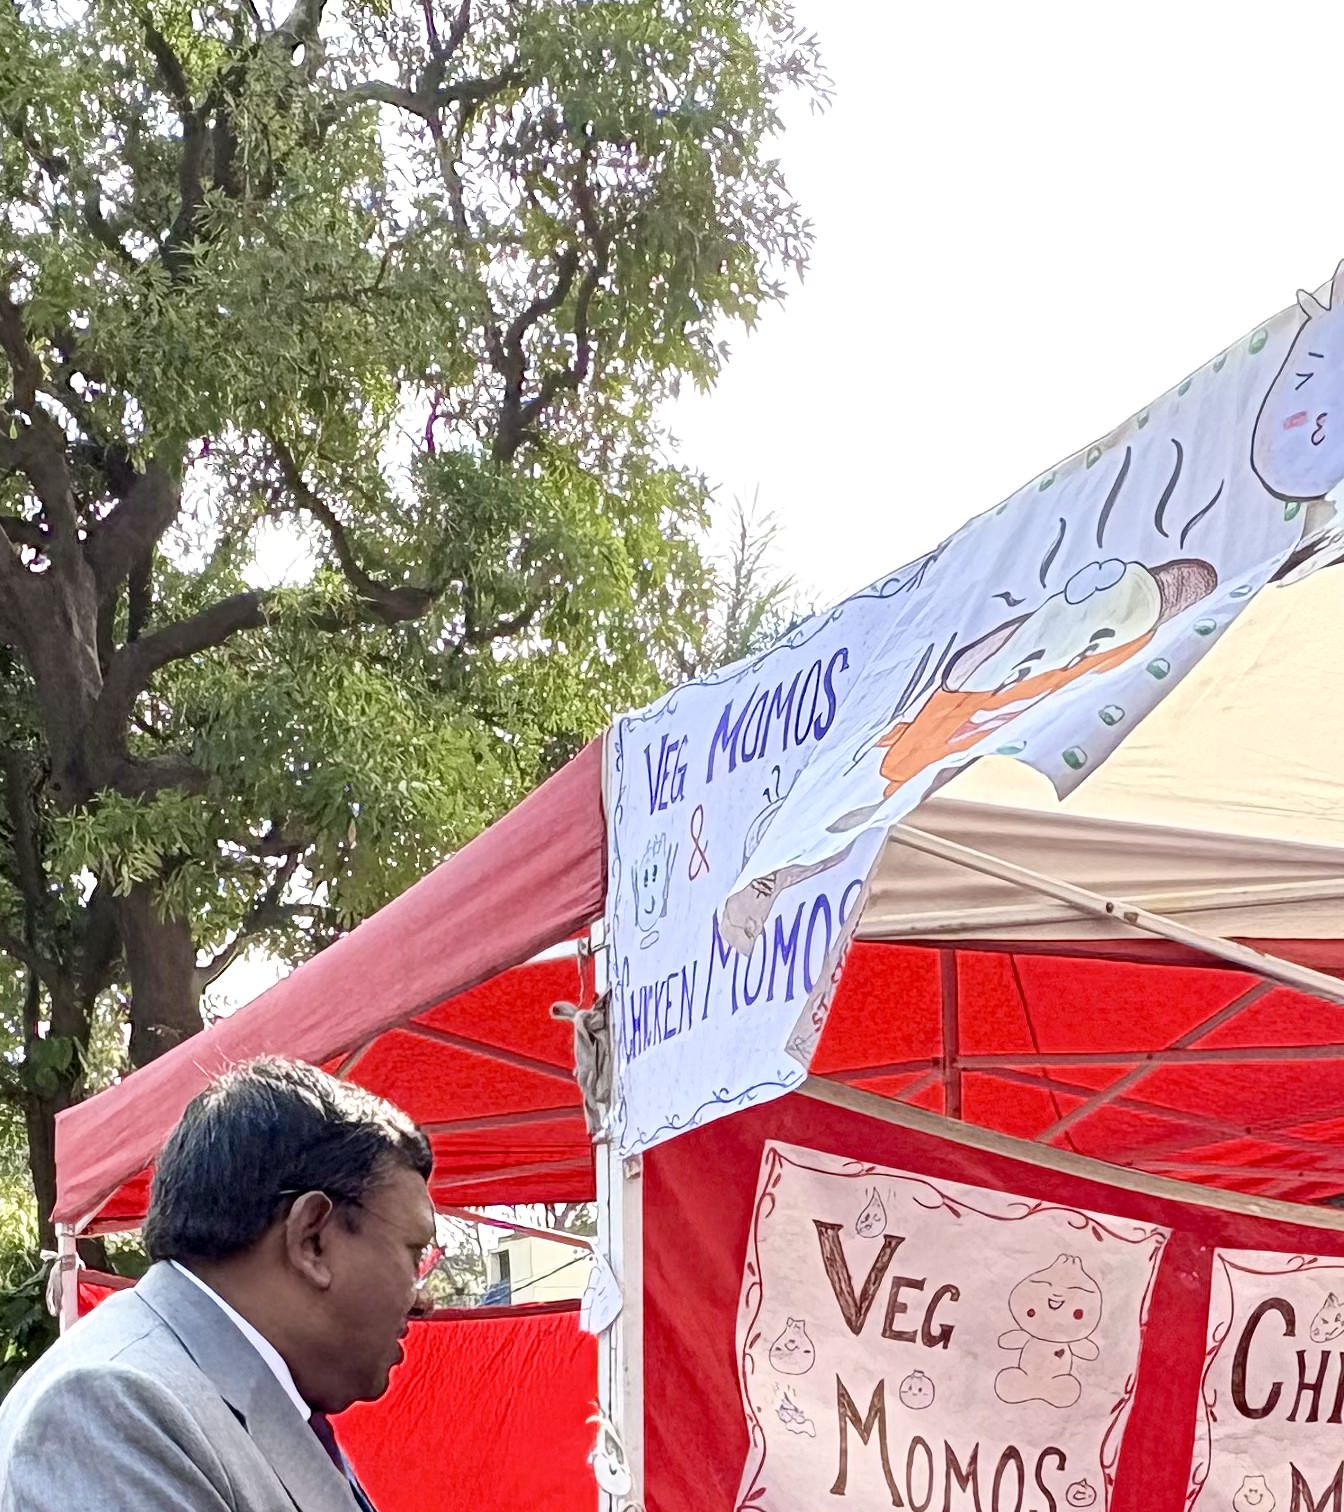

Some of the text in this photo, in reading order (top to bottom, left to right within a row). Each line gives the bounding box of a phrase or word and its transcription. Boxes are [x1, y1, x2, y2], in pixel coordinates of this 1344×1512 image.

[643, 647, 850, 816] VEG MOMOS
[688, 804, 710, 881] &
[812, 1219, 960, 1349] VEG
